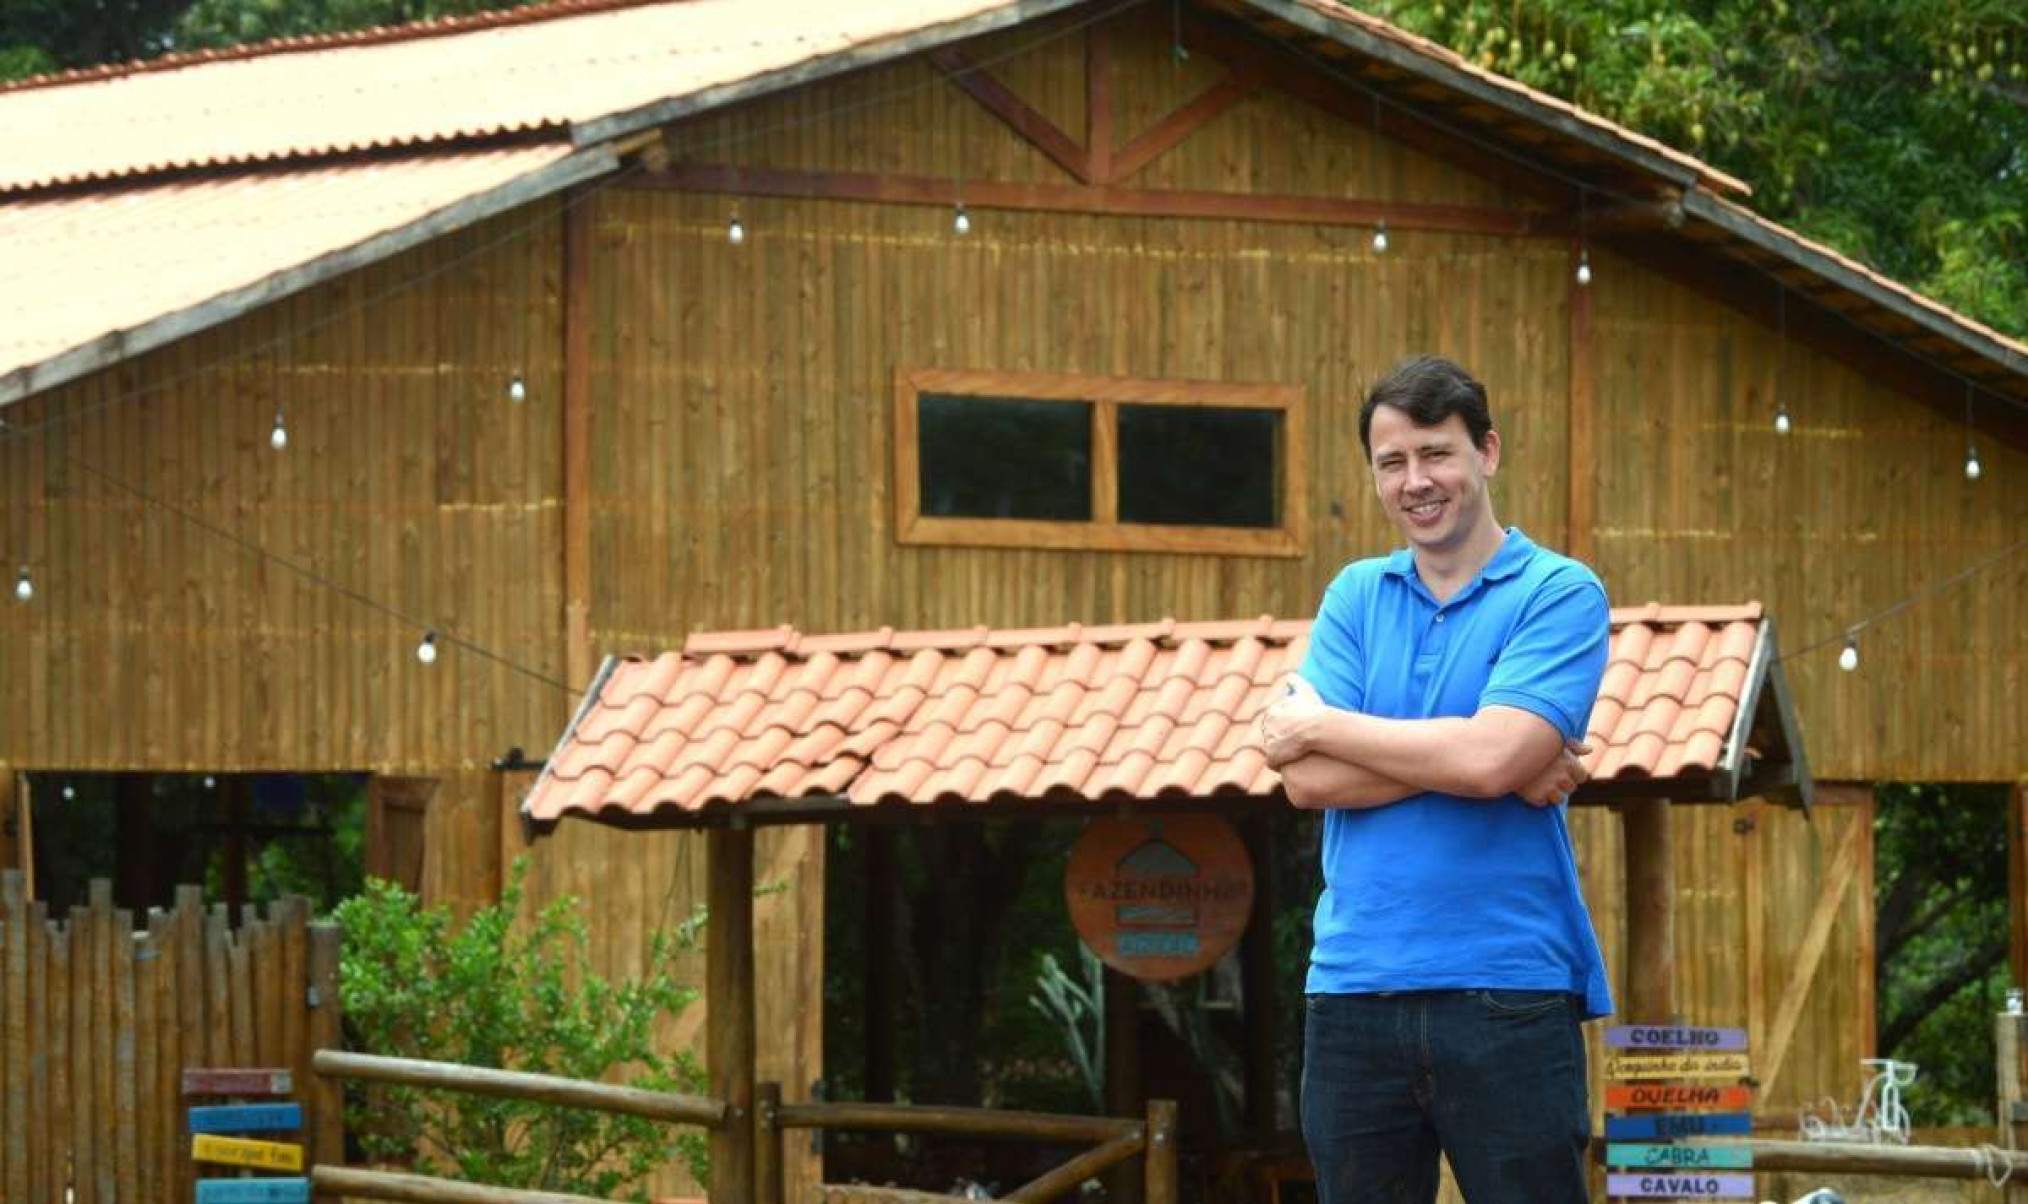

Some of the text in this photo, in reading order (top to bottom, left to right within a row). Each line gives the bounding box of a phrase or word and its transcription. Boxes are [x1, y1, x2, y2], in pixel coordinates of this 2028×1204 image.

[1630, 1029, 1719, 1045] COELHO
[1645, 1147, 1710, 1164] CABRA
[1640, 1178, 1719, 1194] CAVALO
